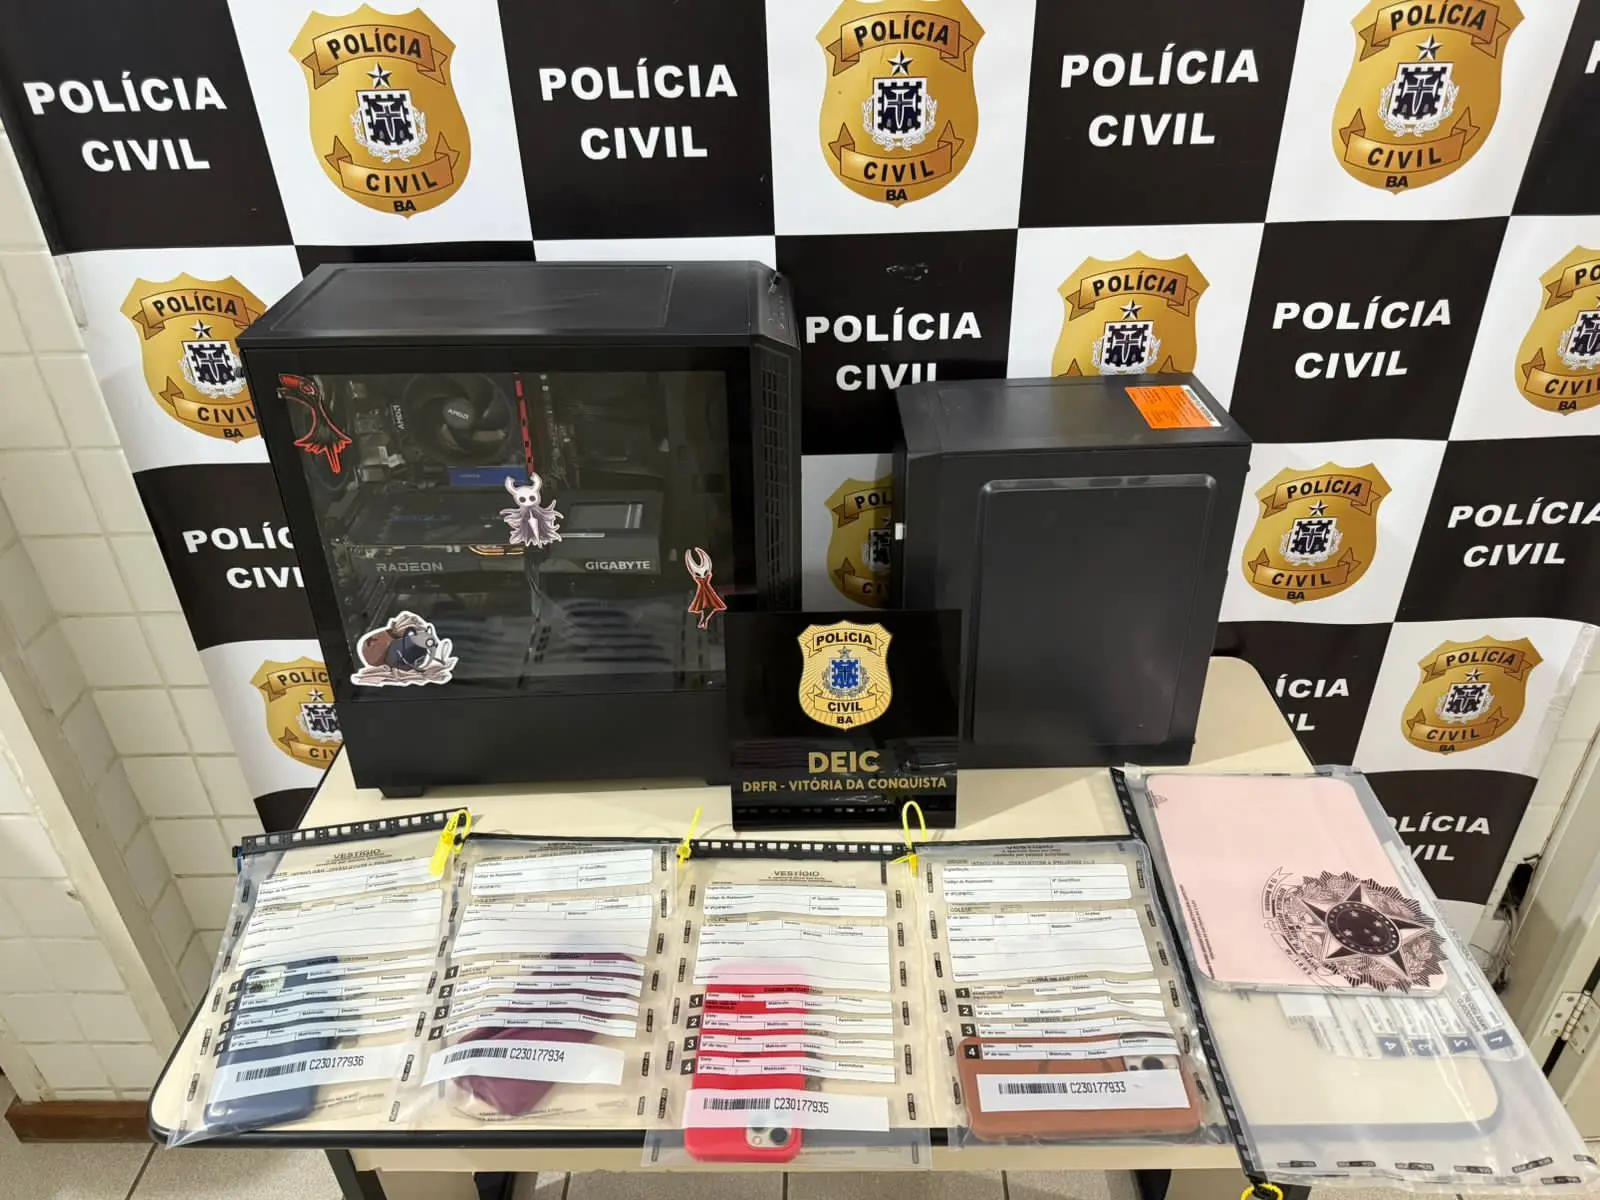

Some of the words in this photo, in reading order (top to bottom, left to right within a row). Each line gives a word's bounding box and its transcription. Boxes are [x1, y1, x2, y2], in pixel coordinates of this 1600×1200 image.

[1391, 0, 1487, 32] POLÍCIA
[853, 14, 949, 48] POLÍCIA
[326, 28, 422, 60] POLÍCIA
[1061, 43, 1259, 89] POLÍCIA
[539, 57, 738, 100] POLÍCIA
[23, 71, 227, 115] POLÍCIA
[1088, 113, 1215, 147] CIVIL
[580, 126, 708, 160] CIVIL
[81, 138, 211, 172] CIVIL
[1367, 147, 1442, 169] CIVIL
[366, 171, 438, 194] CIVIL
[863, 160, 935, 183] CIVIL
[1385, 176, 1409, 188] BA
[886, 189, 908, 201] BA
[393, 200, 416, 213] BA
[1092, 271, 1178, 296] POLÍCIA
[152, 291, 238, 317] POLÍCIA
[1273, 295, 1451, 330] POLÍCIA
[806, 307, 982, 344] POLÍCIA
[1294, 350, 1408, 379] CIVIL
[1544, 379, 1600, 396] CIVI
[1558, 401, 1577, 411] BA
[223, 428, 243, 438] BA
[1286, 477, 1362, 499] POLÍCIA
[182, 521, 295, 553] POLÍC
[585, 560, 651, 571] GIGABYTE
[1463, 542, 1566, 567] CIVIL
[226, 566, 305, 589] CIVI
[375, 563, 444, 573] RADEON
[1271, 573, 1331, 587] CIVIL
[1287, 591, 1305, 600] BA
[1446, 648, 1516, 667] POLÍCIA
[277, 669, 328, 686] POLÍC
[827, 701, 863, 713] CIVIL
[836, 716, 853, 724] BA
[1426, 729, 1481, 741] CIVIL
[808, 752, 880, 773] DEIC
[743, 781, 777, 792] DRFR
[789, 778, 843, 792] VITÓRIA
[846, 779, 865, 790] DA
[867, 777, 947, 790] CONQUISTA
[1387, 812, 1490, 836] LÍCIA
[309, 1055, 364, 1071] C230177936
[510, 1047, 565, 1063] C230177934
[1069, 1080, 1126, 1093] C230177933
[774, 1096, 829, 1114] C230177935
